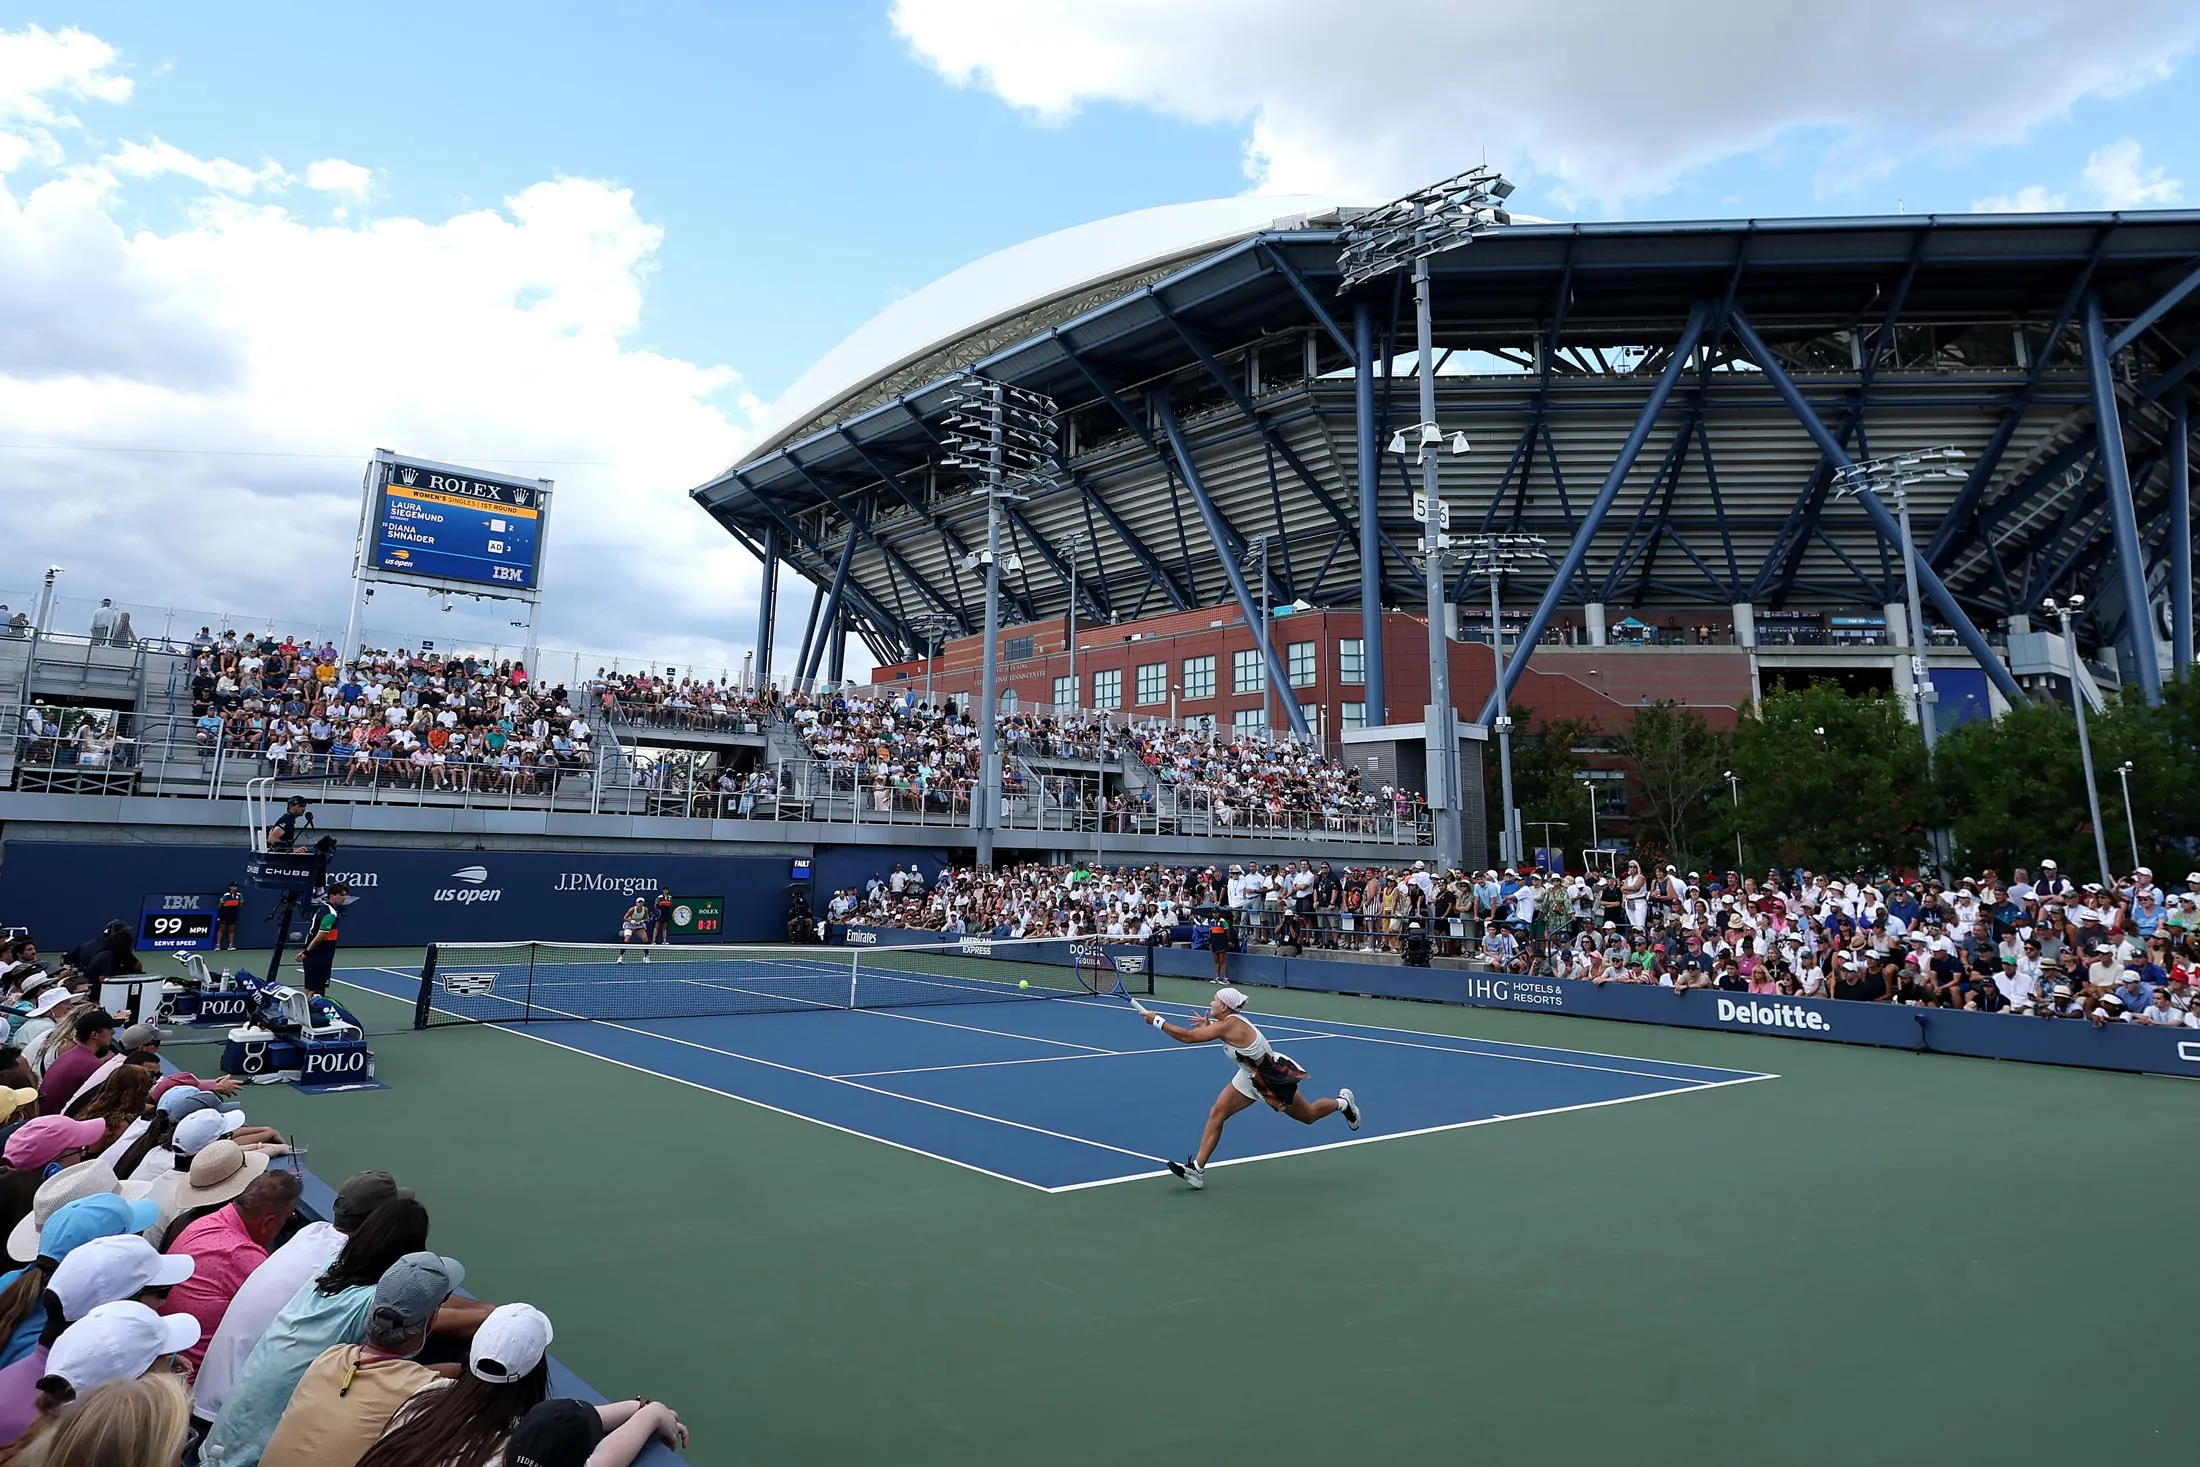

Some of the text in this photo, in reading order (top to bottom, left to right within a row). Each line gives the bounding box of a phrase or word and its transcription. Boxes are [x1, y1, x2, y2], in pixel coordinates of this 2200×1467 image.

[428, 474, 501, 500] ROLEX
[391, 500, 422, 512] LAURA
[413, 490, 447, 502] WOMEN'S
[448, 496, 476, 507] SINGLES
[494, 504, 518, 514] ROUND
[1418, 499, 1425, 516] 5
[390, 508, 444, 523] SIEGEMUND
[1440, 507, 1446, 522] 6
[388, 522, 416, 534] DIANA
[387, 530, 435, 545] SHNAIDER
[490, 543, 502, 551] AD
[394, 560, 413, 568] open
[492, 565, 523, 582] IBM
[794, 860, 811, 868] FAULT
[265, 867, 310, 877] CHUBB
[554, 873, 659, 897] J.P.Morgan
[163, 895, 200, 910] IBM
[433, 888, 501, 905] us open
[154, 917, 208, 934] 99 MPH
[697, 919, 718, 930] 0:21
[846, 929, 877, 944] Emirates
[962, 944, 992, 956] EXPRESS
[1468, 978, 1508, 1001] IHG
[1513, 982, 1562, 995] HOTELS &
[200, 999, 246, 1015] POLO
[1513, 993, 1563, 1006] RESORTS
[1717, 998, 1831, 1032] Deloitte.
[305, 1051, 364, 1074] POLO
